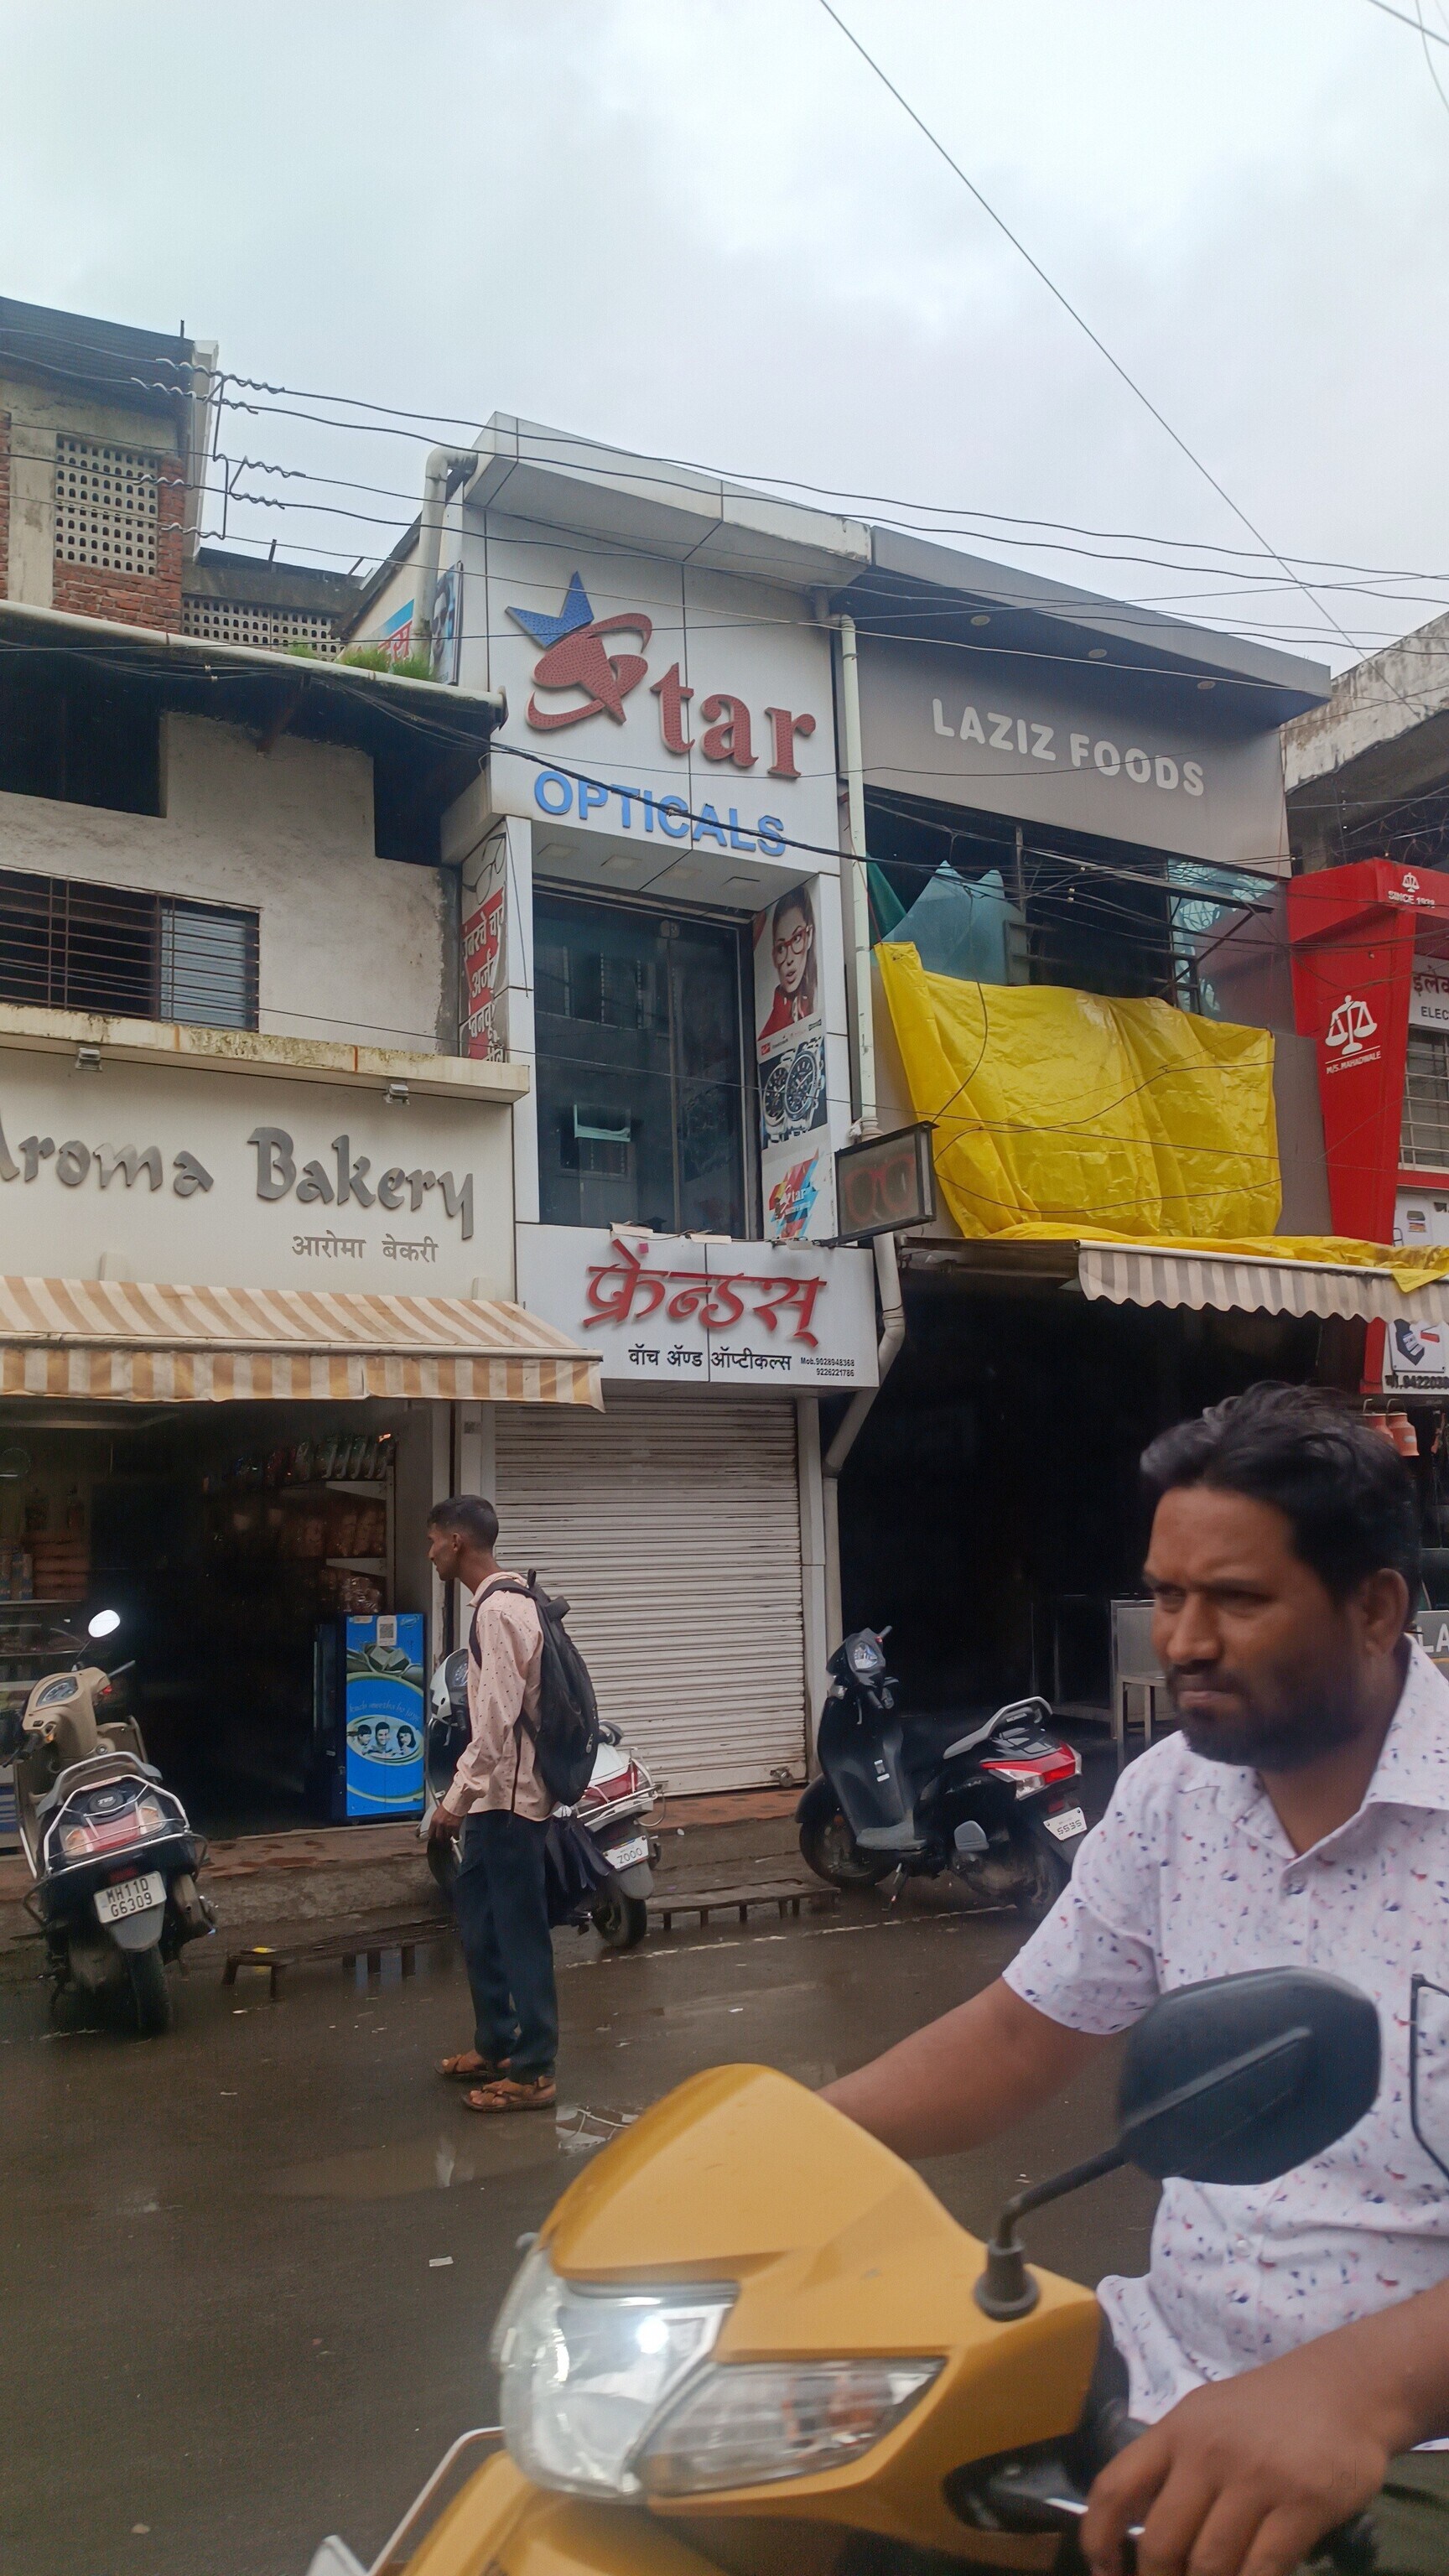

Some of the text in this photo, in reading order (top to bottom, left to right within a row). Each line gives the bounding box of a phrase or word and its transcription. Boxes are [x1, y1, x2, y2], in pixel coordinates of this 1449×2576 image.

[932, 698, 1204, 797] LAZIZ FOODS
[533, 770, 787, 857] OPTICALS
[246, 1126, 474, 1239] Bakery
[292, 1229, 439, 1263] आरोमा बेकरी
[628, 1343, 660, 1366] वॉच
[711, 1346, 792, 1371] ऑप्टीकल्स
[106, 1877, 149, 1904] MH11D
[110, 1892, 153, 1917] G6309
